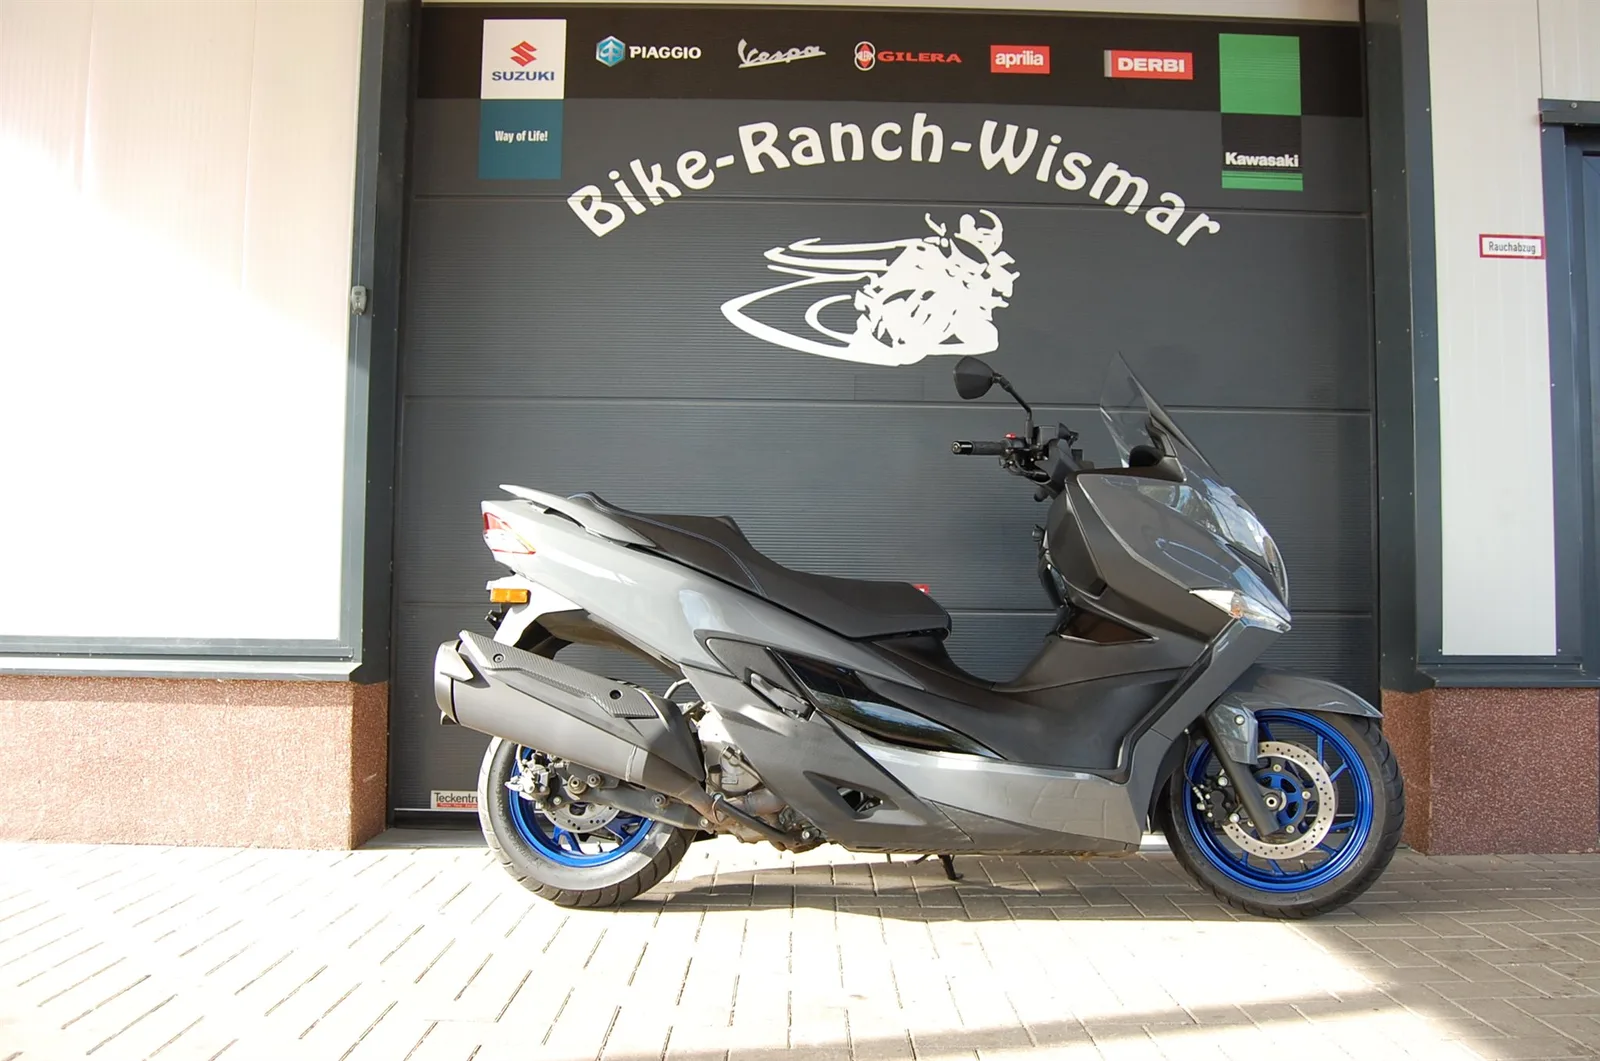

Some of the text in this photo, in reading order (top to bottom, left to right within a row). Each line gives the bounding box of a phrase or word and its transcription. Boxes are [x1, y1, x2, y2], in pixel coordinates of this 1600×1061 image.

[629, 46, 702, 60] PIAGGIO
[737, 38, 826, 68] Vespa
[877, 51, 962, 63] GILERA
[995, 50, 1044, 67] aprilia
[1117, 57, 1186, 73] DERBI
[492, 71, 555, 82] SUZUKI
[494, 130, 548, 143] Way of Life!
[1225, 152, 1299, 167] Kawasaki
[567, 112, 1221, 247] Bike-Ranch-Wismar
[1488, 241, 1536, 254] Rauchabzug
